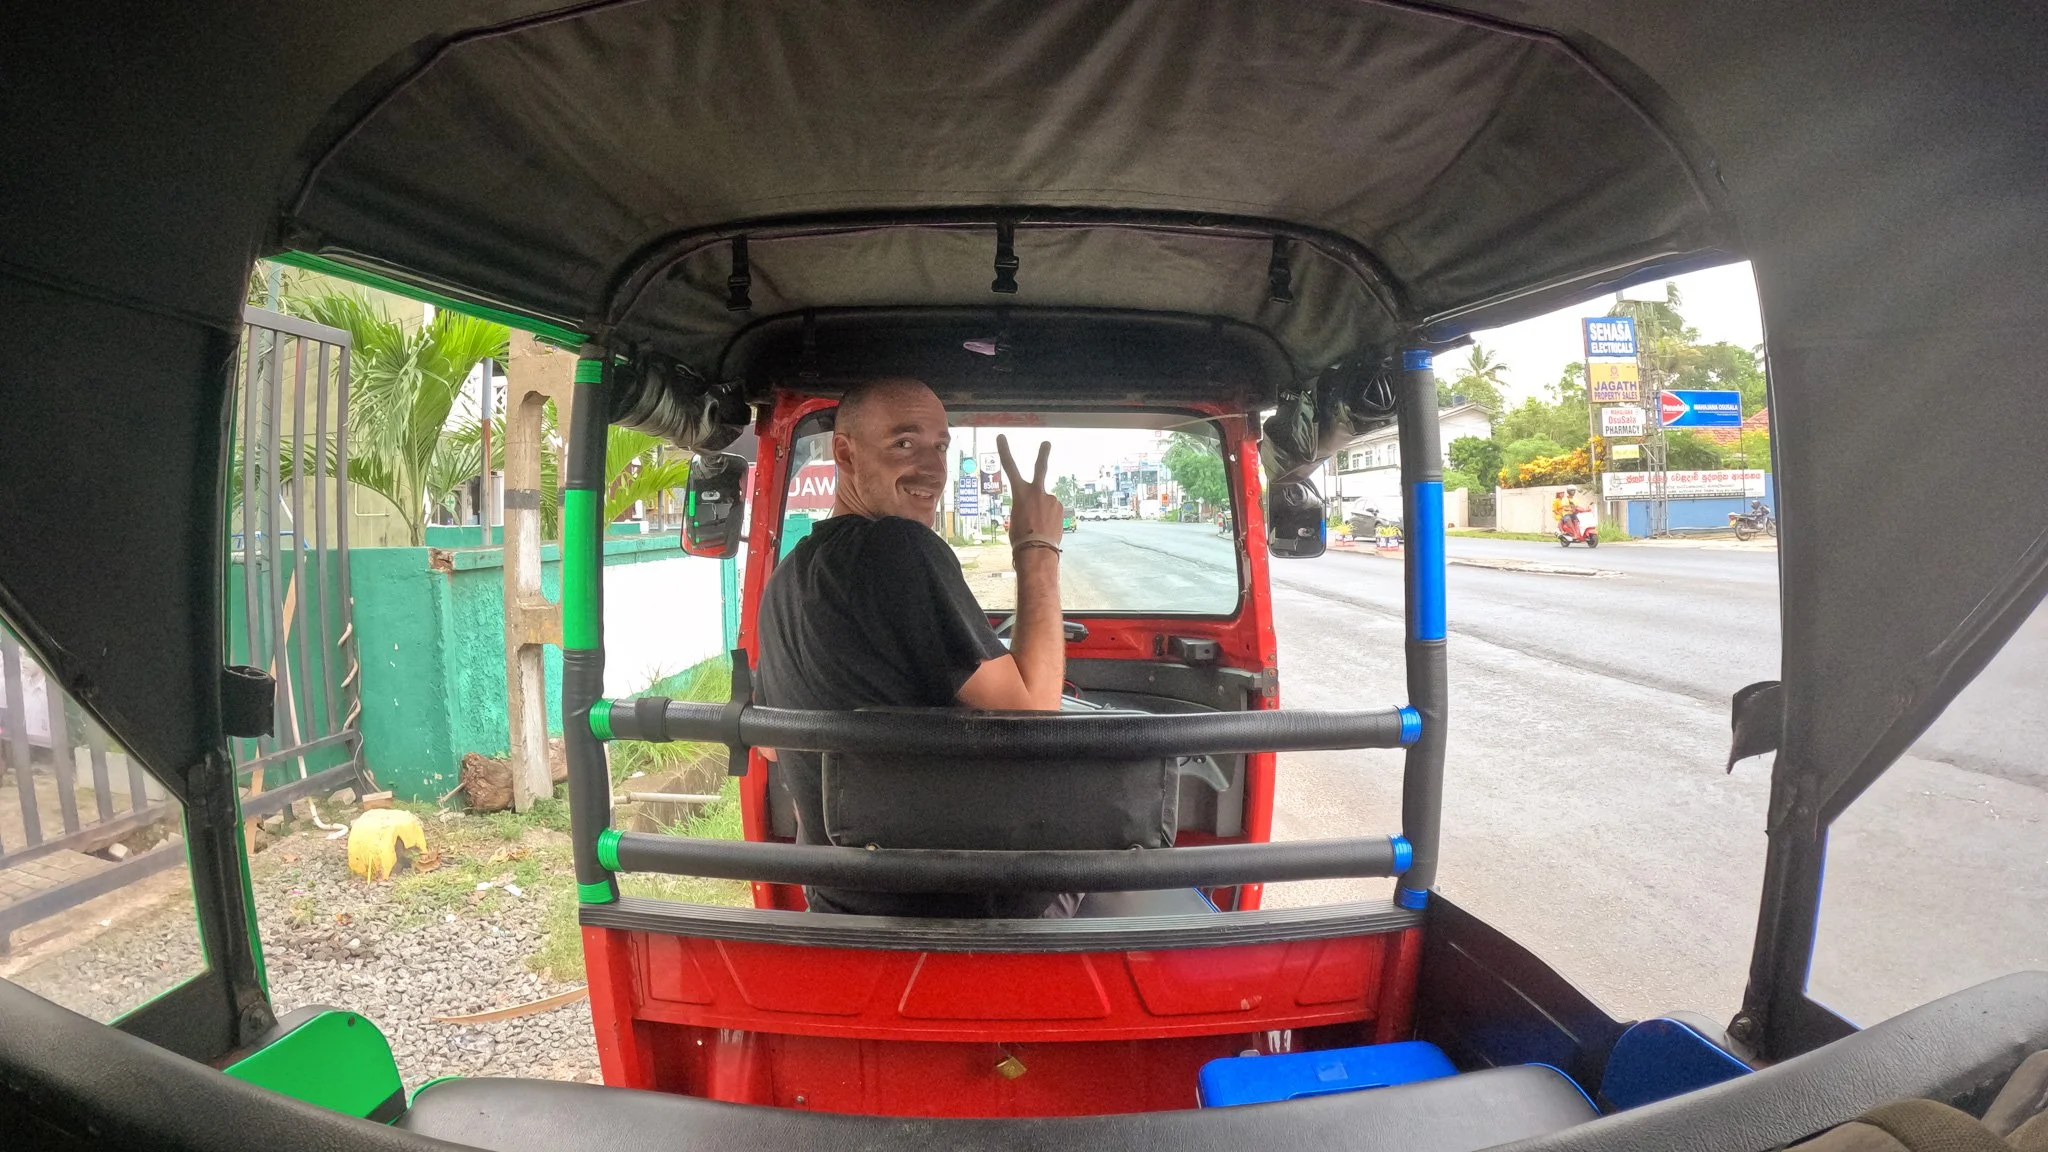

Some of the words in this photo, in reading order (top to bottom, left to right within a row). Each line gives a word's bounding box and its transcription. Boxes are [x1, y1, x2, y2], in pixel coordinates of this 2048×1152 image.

[1589, 322, 1632, 341] SEHASA
[1591, 342, 1633, 353] ELECTRICALS
[1594, 381, 1637, 391] JAGATH
[1594, 392, 1620, 401] PROPERTY
[1622, 391, 1638, 400] SALES
[1605, 425, 1640, 435] PHARMACY
